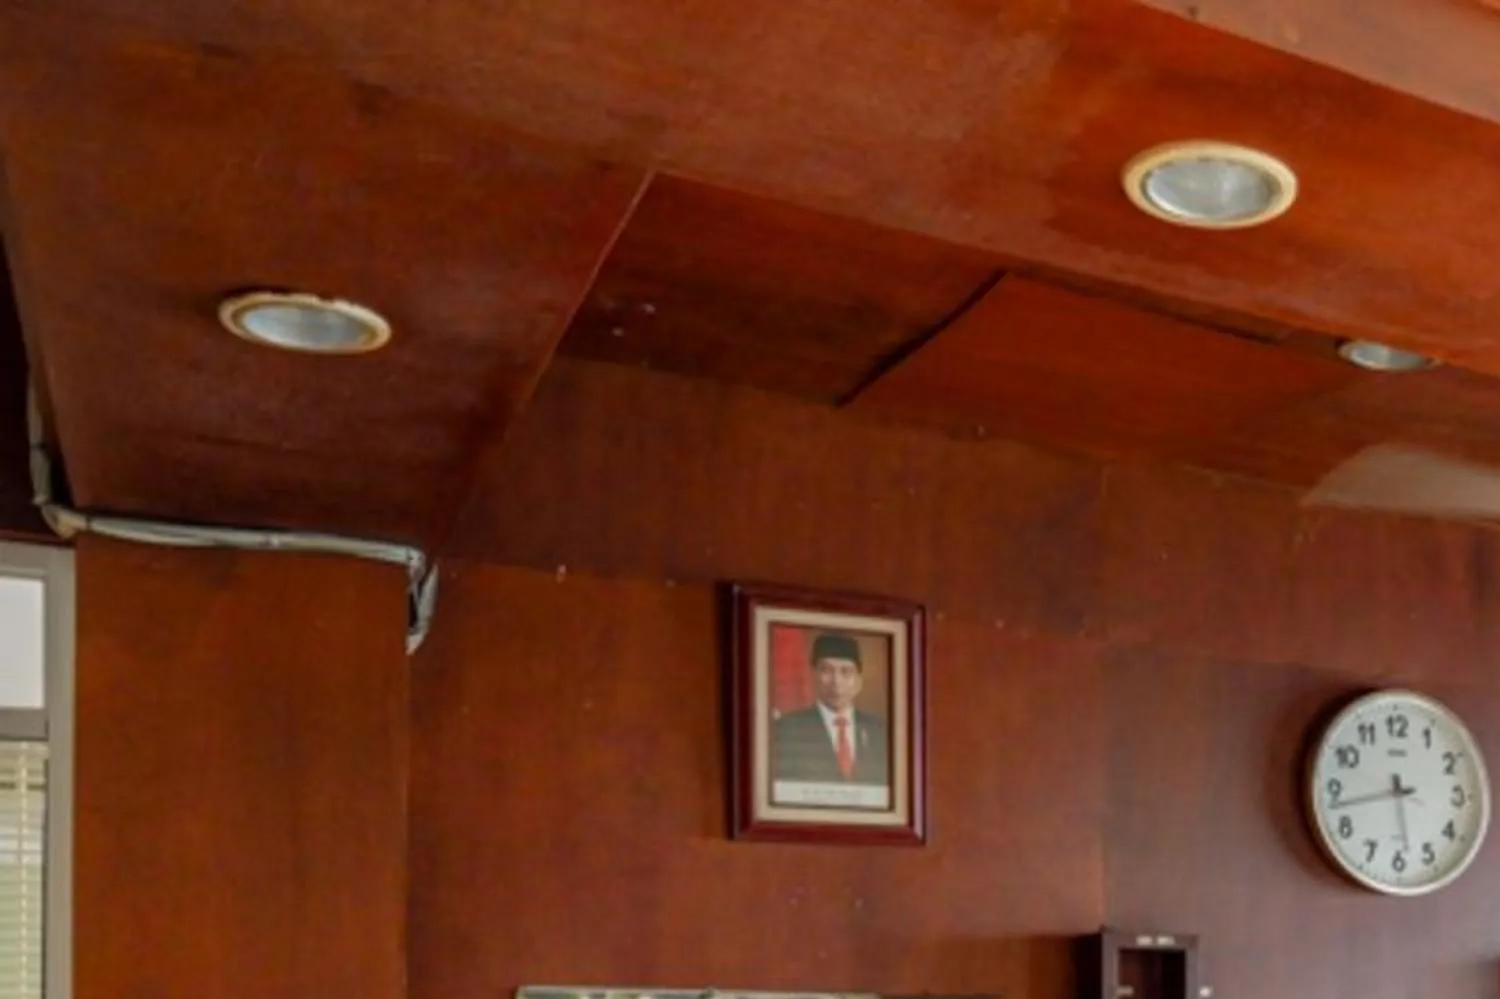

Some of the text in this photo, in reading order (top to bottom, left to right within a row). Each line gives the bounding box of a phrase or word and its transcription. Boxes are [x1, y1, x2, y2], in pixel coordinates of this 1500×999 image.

[1357, 723, 1376, 746] 11
[1386, 714, 1409, 739] 12
[1423, 727, 1432, 749] 1
[1335, 745, 1360, 769] 10
[1442, 751, 1456, 775] 2
[1327, 777, 1342, 808] 9
[1451, 785, 1465, 808] 3
[1338, 816, 1353, 840] 8
[1442, 820, 1456, 841] 4
[1363, 839, 1378, 863] 7
[1392, 851, 1407, 873] 6
[1422, 842, 1436, 866] 5
